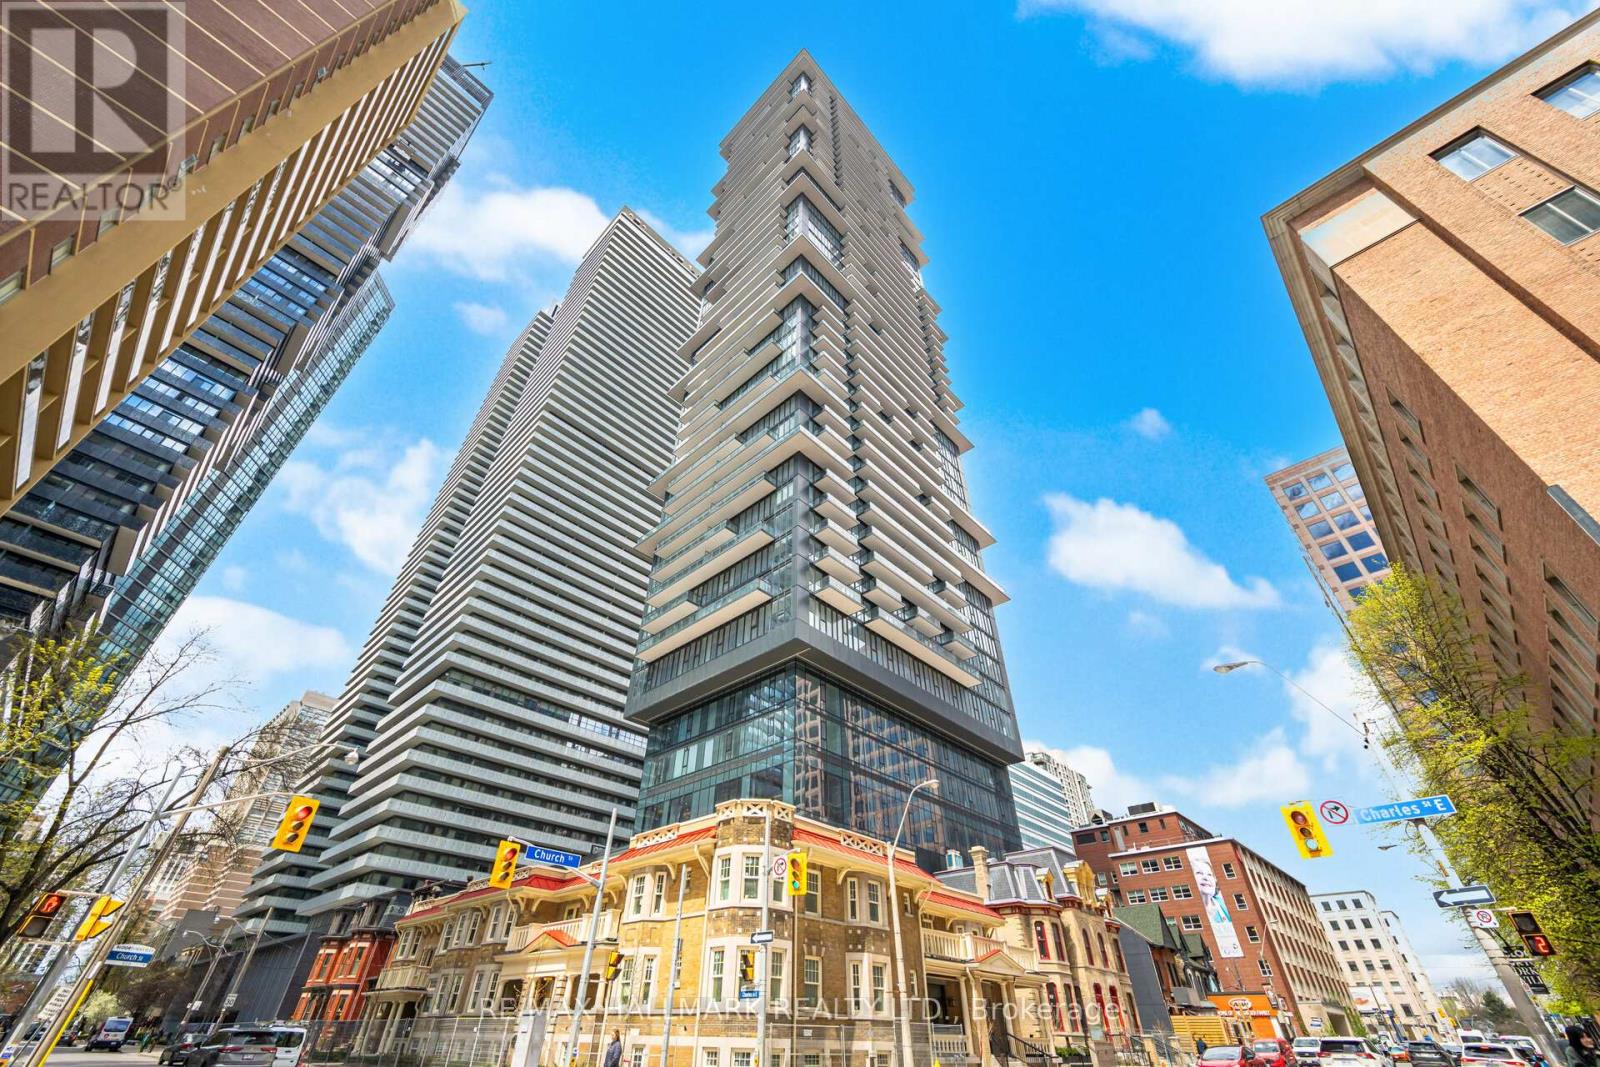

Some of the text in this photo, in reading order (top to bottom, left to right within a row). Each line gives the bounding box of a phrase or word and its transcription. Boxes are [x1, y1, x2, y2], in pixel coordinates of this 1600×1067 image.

[1360, 804, 1421, 821] Charles
[1433, 798, 1447, 811] E
[534, 849, 565, 863] Church
[116, 952, 137, 961] Church
